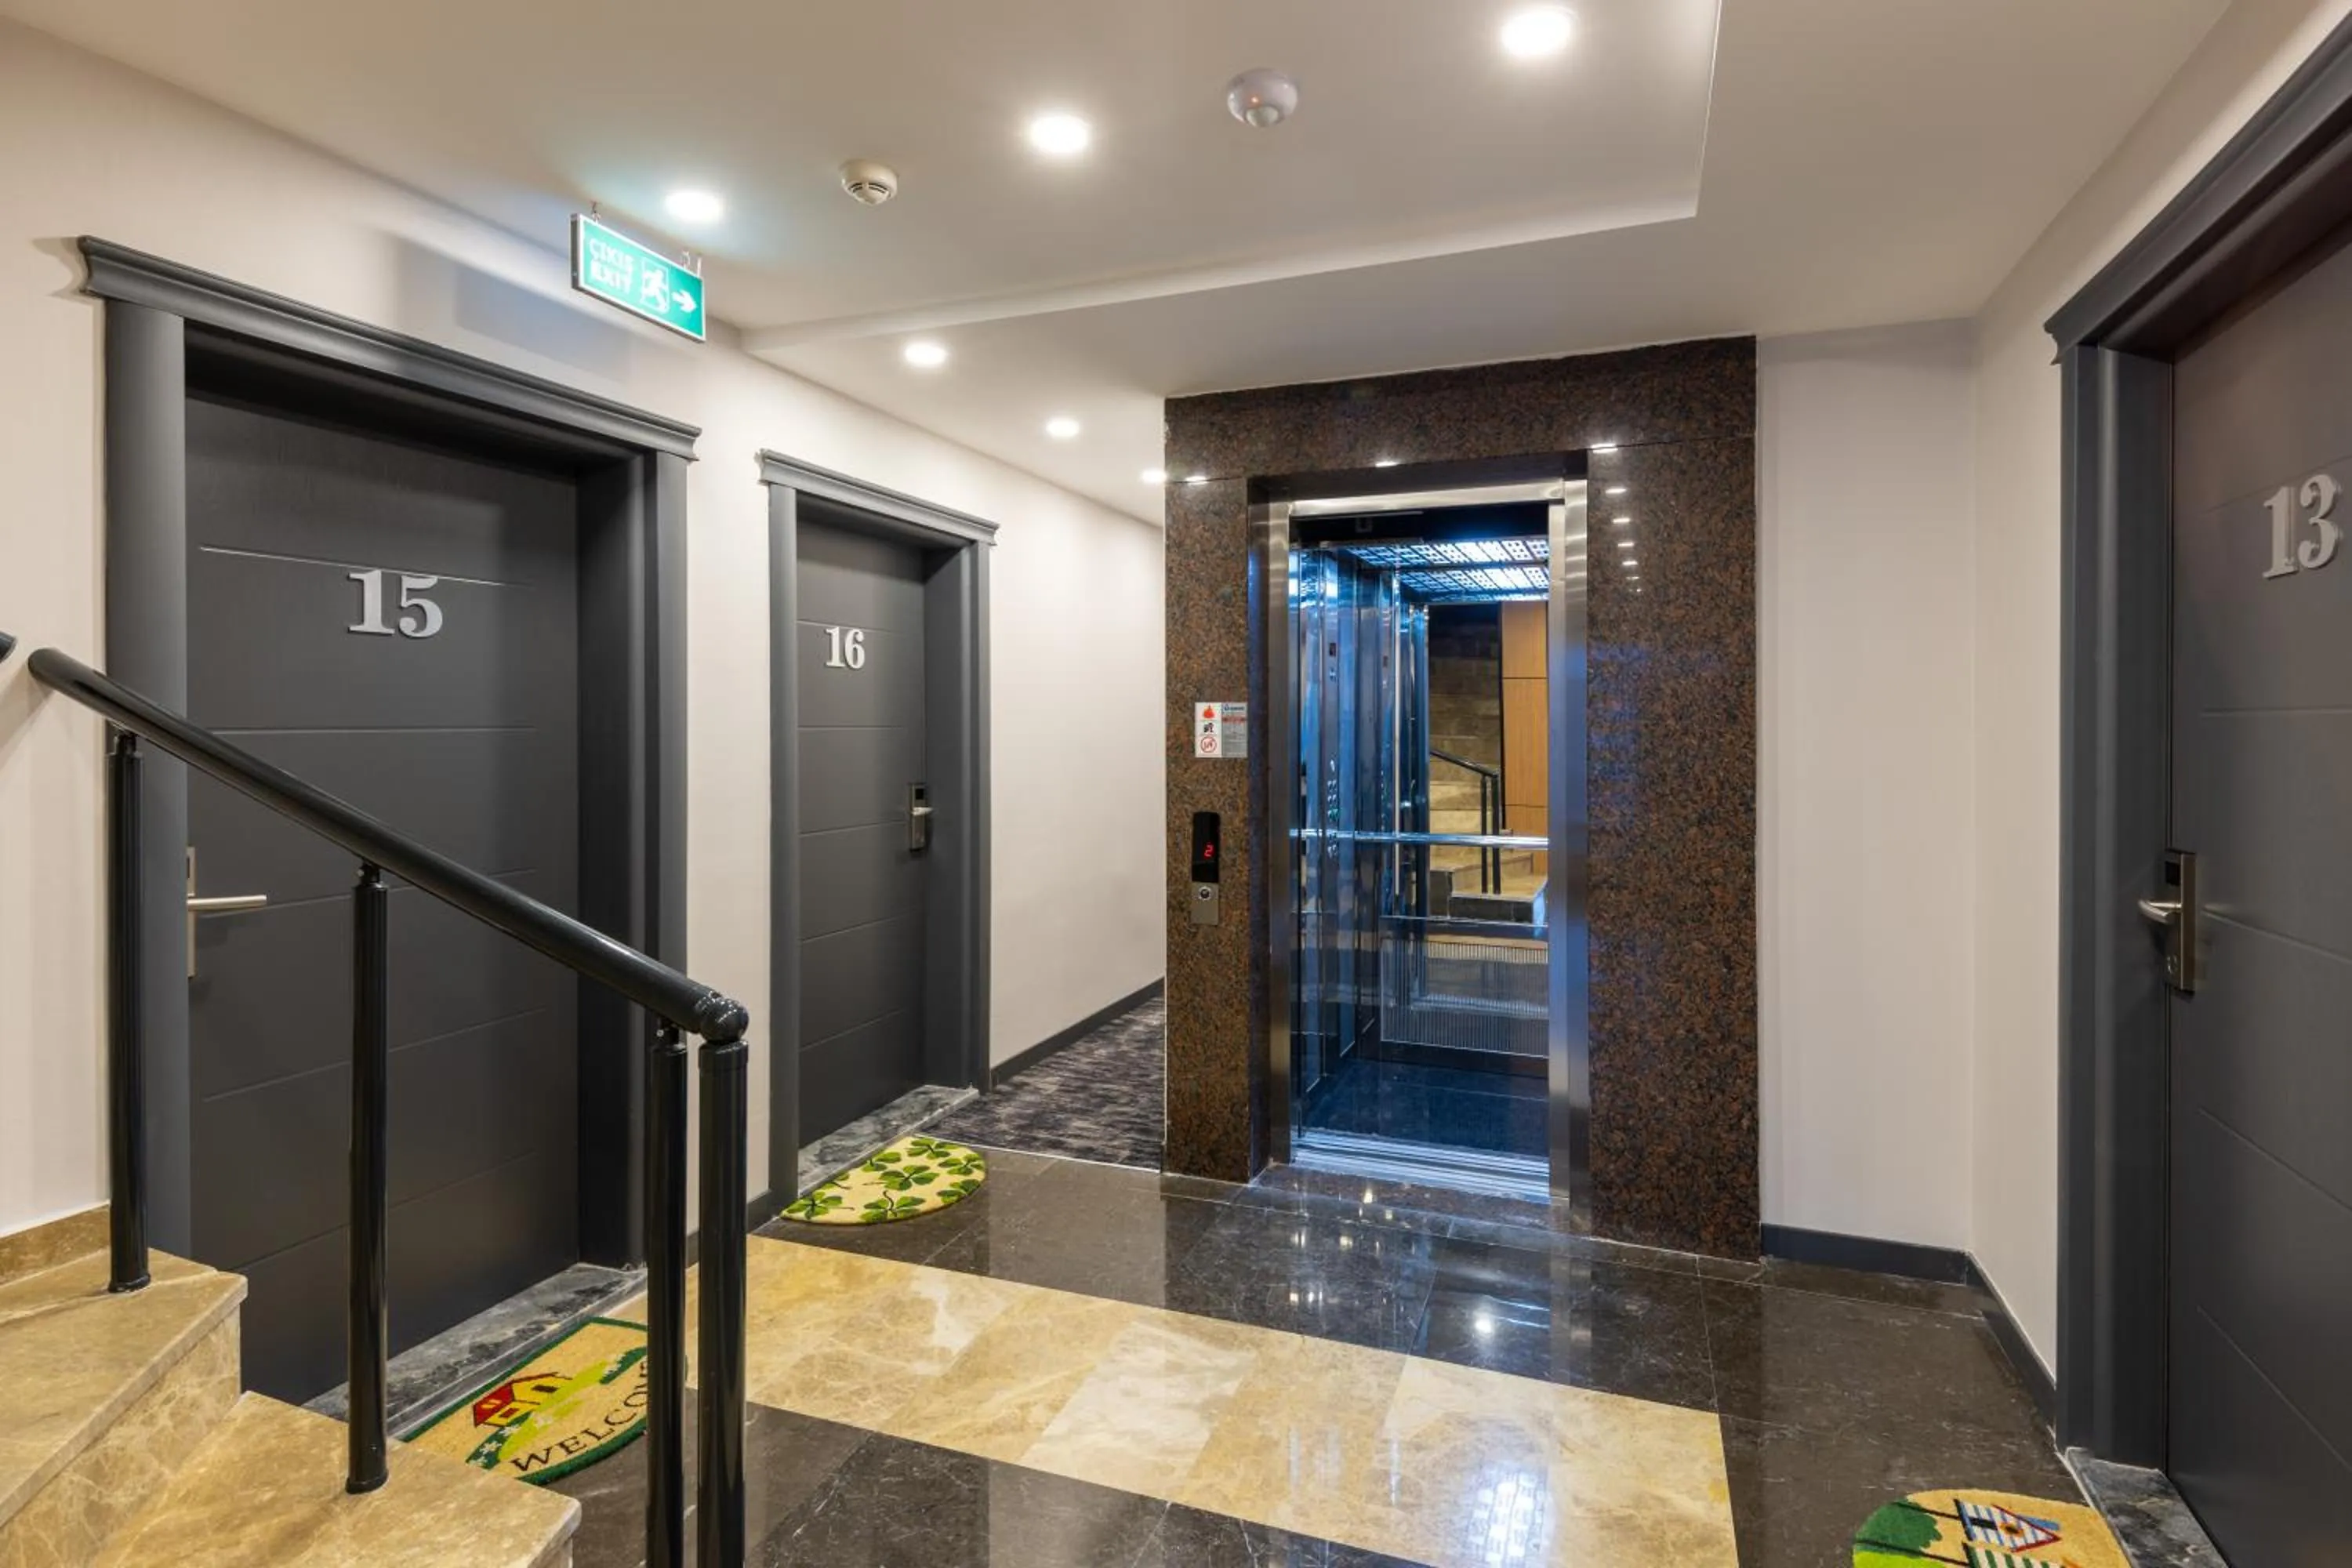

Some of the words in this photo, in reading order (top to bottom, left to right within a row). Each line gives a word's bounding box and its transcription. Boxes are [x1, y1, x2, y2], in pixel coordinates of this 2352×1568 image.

[590, 260, 633, 295] EXIT
[2262, 474, 2340, 579] 13
[349, 569, 443, 637] 15
[826, 626, 866, 670] 16
[1203, 844, 1214, 858] 2
[510, 1360, 648, 1472] WELCO
